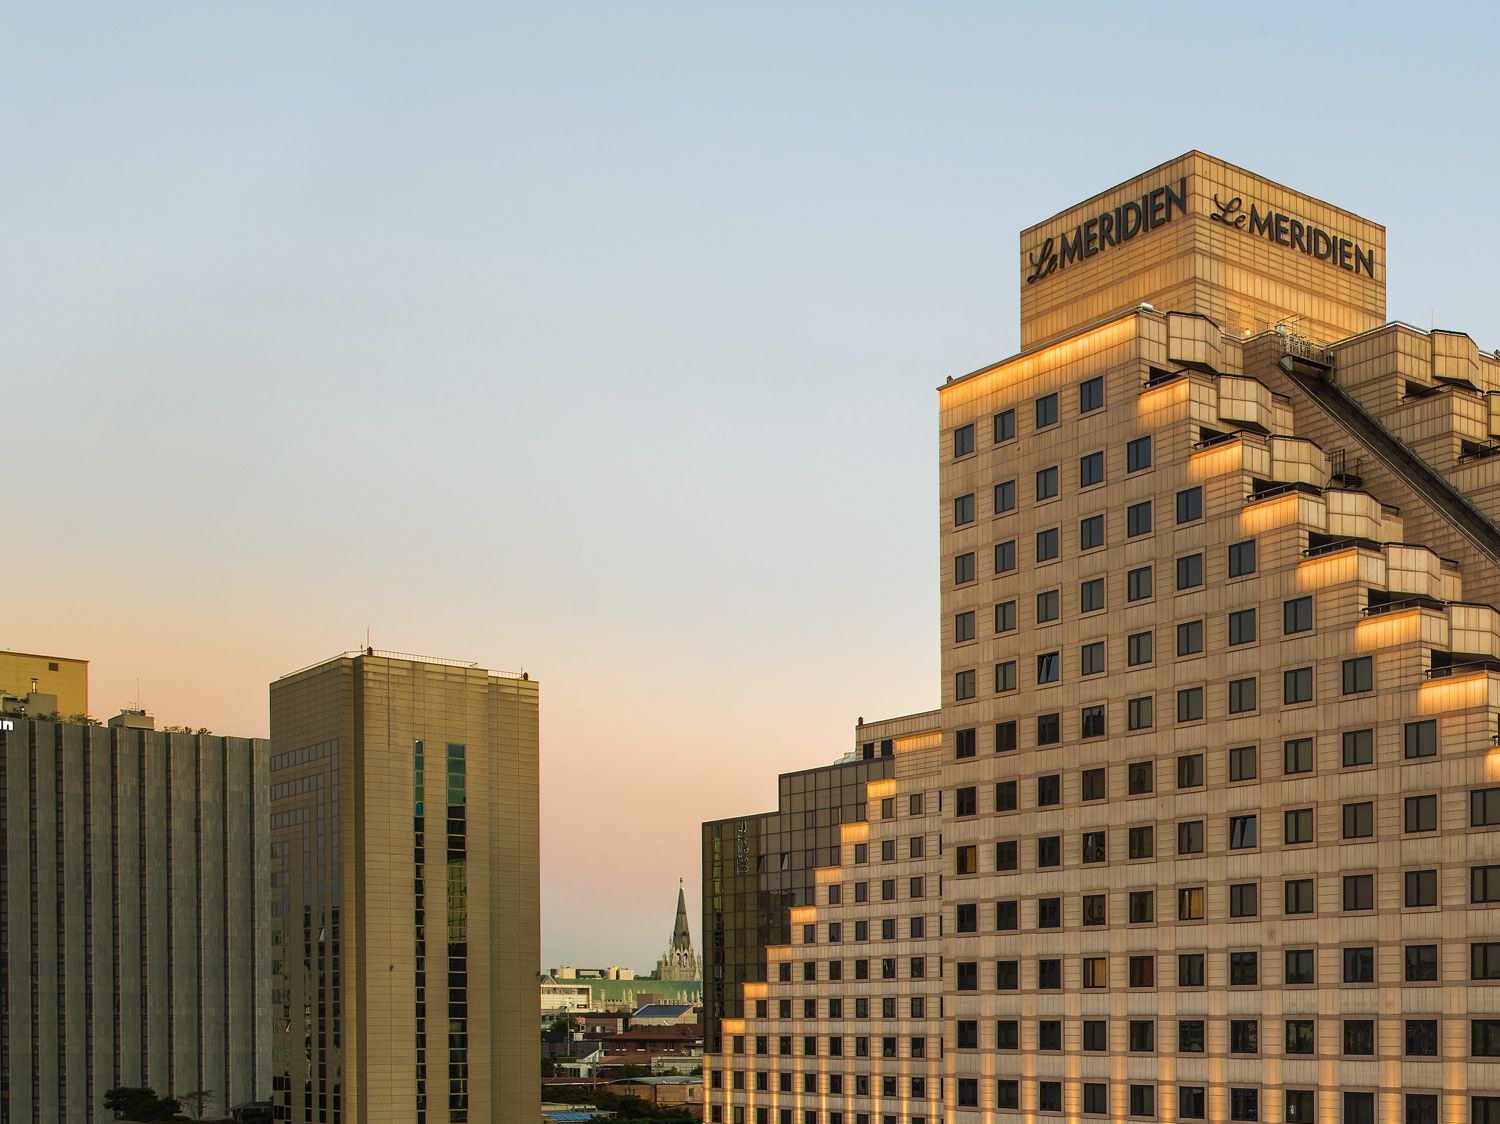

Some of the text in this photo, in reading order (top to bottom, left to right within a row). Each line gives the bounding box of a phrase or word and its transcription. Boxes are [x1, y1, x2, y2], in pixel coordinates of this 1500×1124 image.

[1026, 176, 1188, 285] Le MERIDIEN
[1210, 193, 1375, 279] Le MERIDIEN
